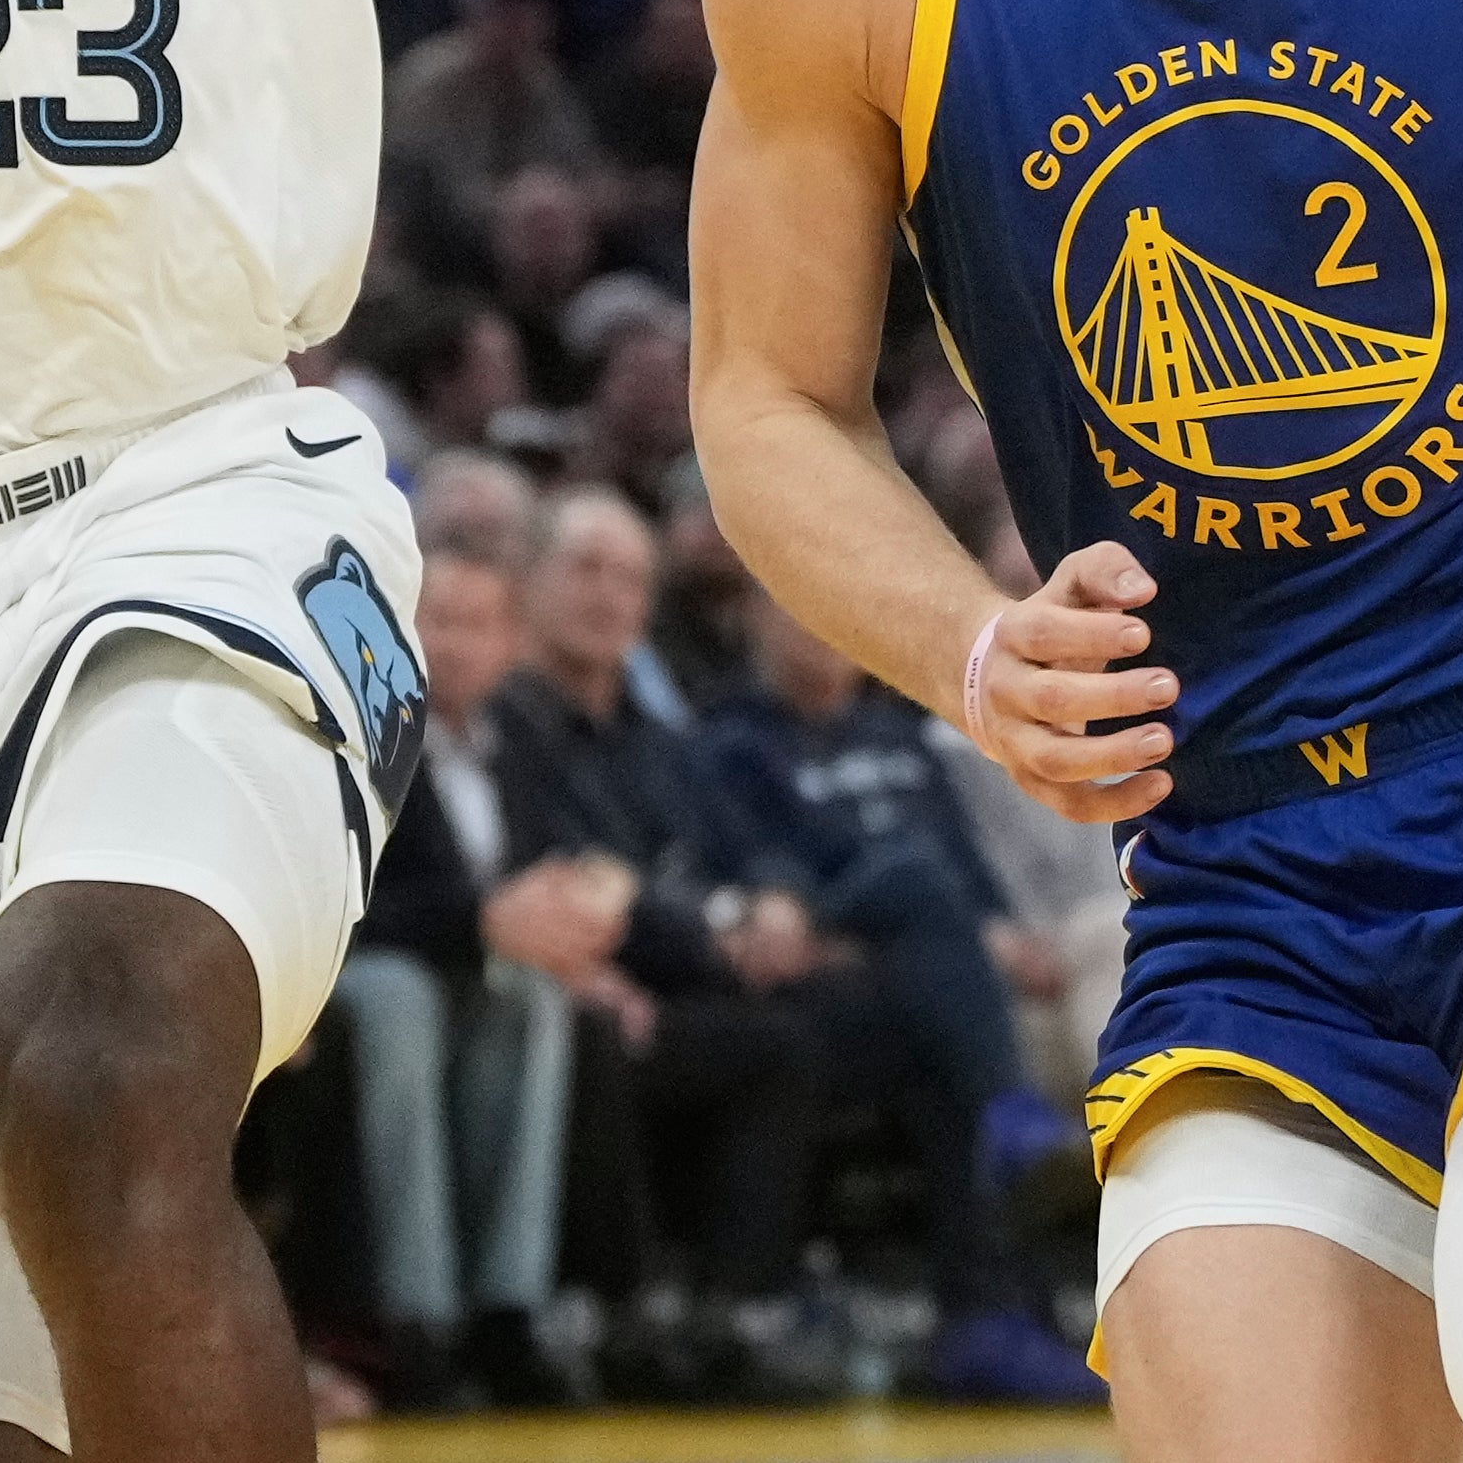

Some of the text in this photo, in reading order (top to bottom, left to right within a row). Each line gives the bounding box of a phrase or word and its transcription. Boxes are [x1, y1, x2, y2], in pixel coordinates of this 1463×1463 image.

[1021, 38, 1434, 191] GOLDEN STATE
[1304, 181, 1379, 288] 2
[1298, 722, 1369, 787] W
